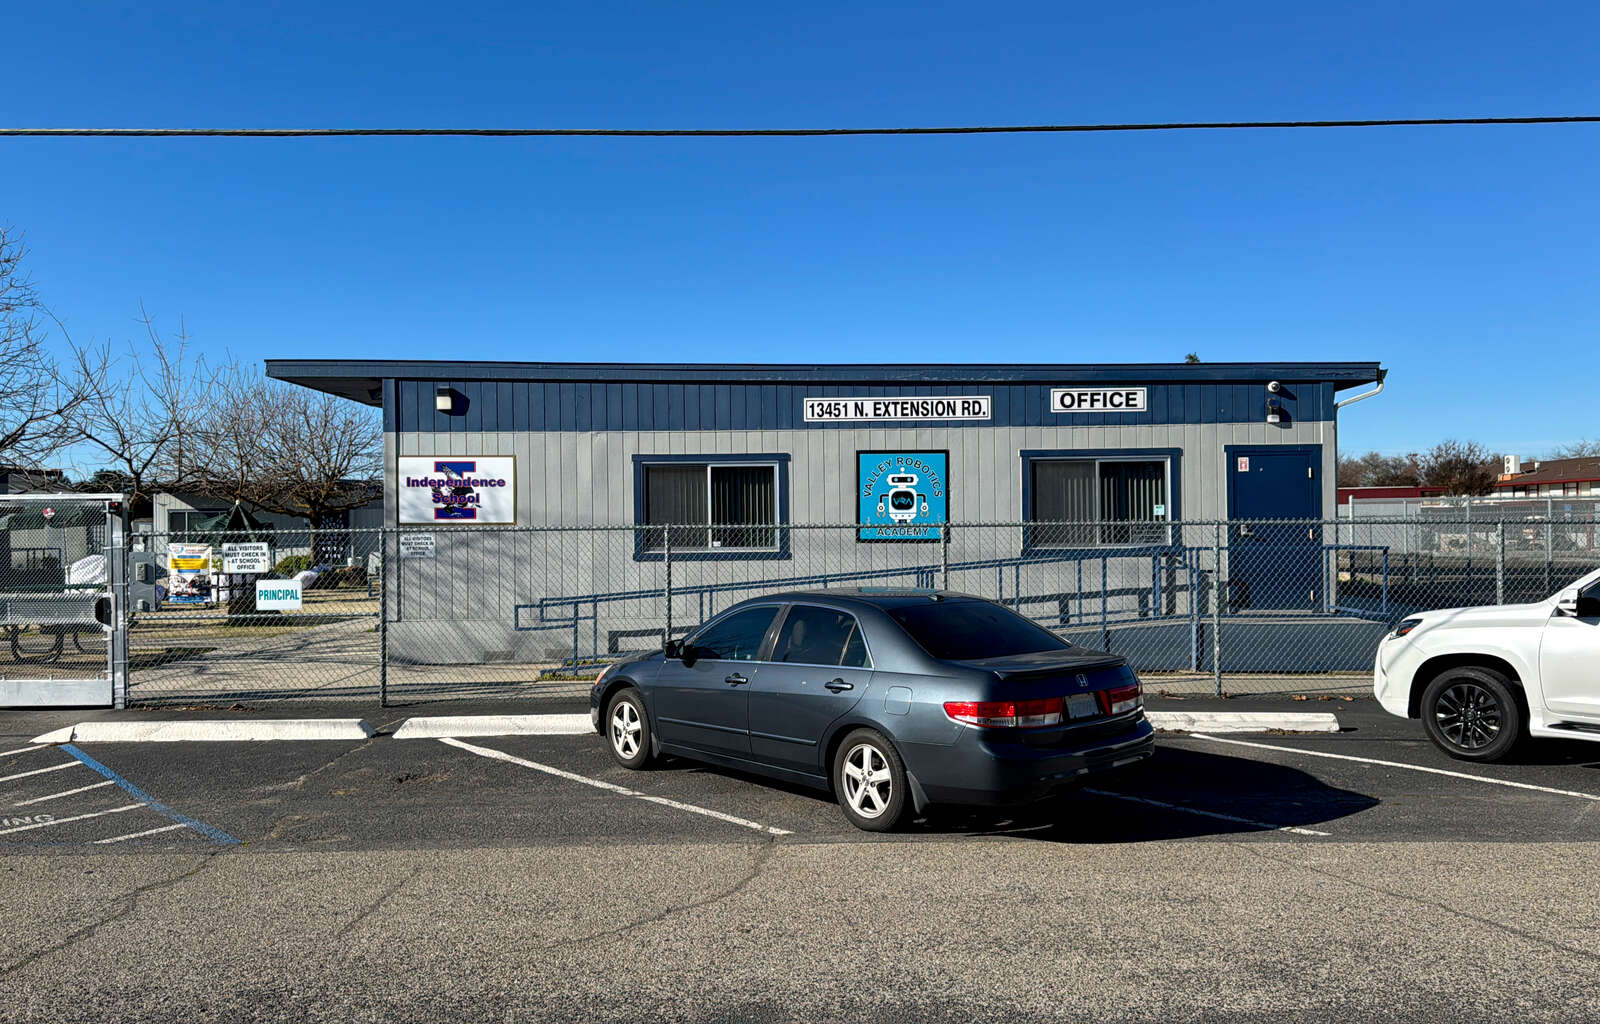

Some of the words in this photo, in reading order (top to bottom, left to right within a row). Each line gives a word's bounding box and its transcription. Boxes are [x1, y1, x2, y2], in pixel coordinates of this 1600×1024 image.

[1059, 391, 1138, 408] OFFICE
[808, 402, 848, 418] 13451
[854, 401, 868, 417] N.
[873, 400, 956, 417] EXTENSION
[961, 399, 987, 416] RD.
[406, 476, 506, 488] Independence
[863, 458, 893, 498] VALLEY
[896, 457, 943, 498] ROBOTICS
[432, 493, 480, 504] School
[877, 527, 929, 537] ACADEMY
[258, 589, 300, 601] PRINCIPAL
